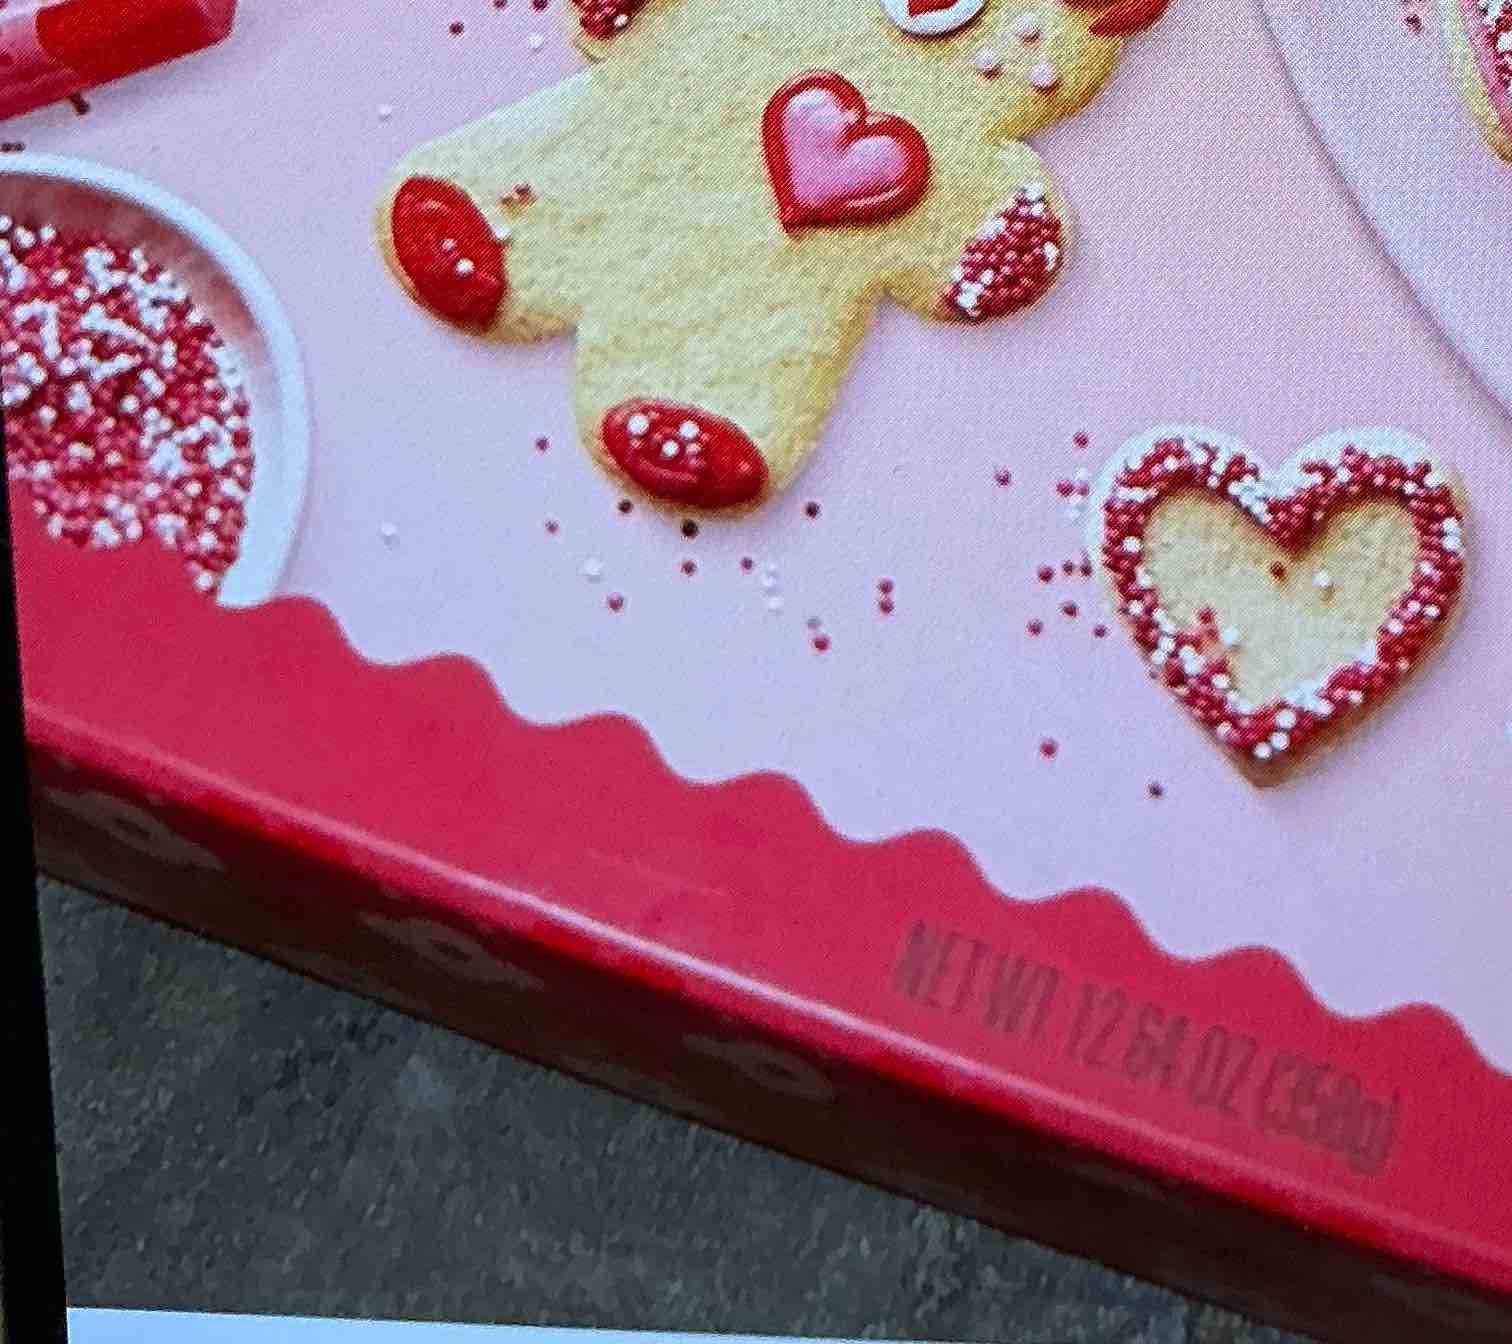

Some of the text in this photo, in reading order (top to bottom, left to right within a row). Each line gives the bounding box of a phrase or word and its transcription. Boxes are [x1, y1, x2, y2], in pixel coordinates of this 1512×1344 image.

[893, 920, 986, 1014] NET
[984, 954, 1062, 1042] WT
[1188, 1024, 1260, 1118] OZ
